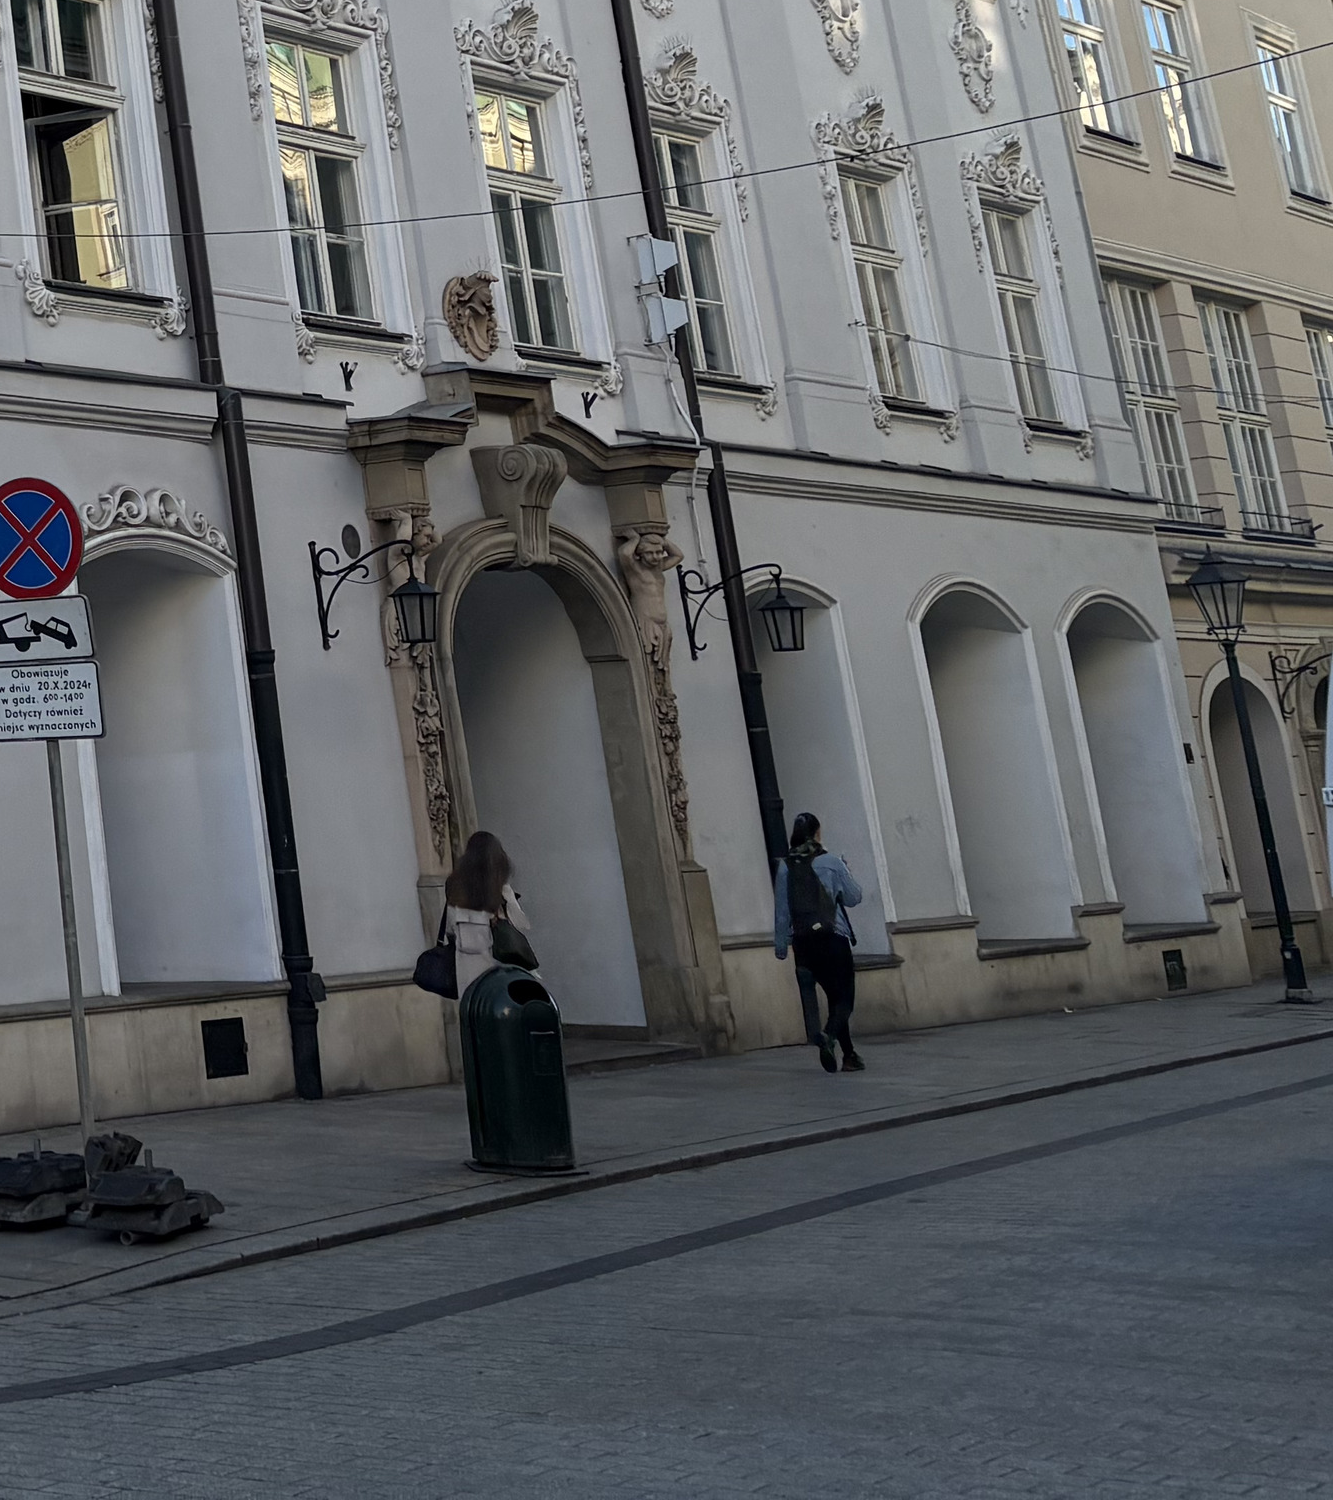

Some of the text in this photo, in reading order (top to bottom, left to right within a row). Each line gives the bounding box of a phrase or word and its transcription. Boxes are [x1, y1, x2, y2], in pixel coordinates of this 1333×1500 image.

[11, 667, 69, 679] Obowiązuje
[9, 683, 31, 693] dniu
[37, 680, 92, 691] 20.X.2024r
[5, 705, 84, 720] Dotyczy również
[28, 719, 97, 733] wyznaczonych
